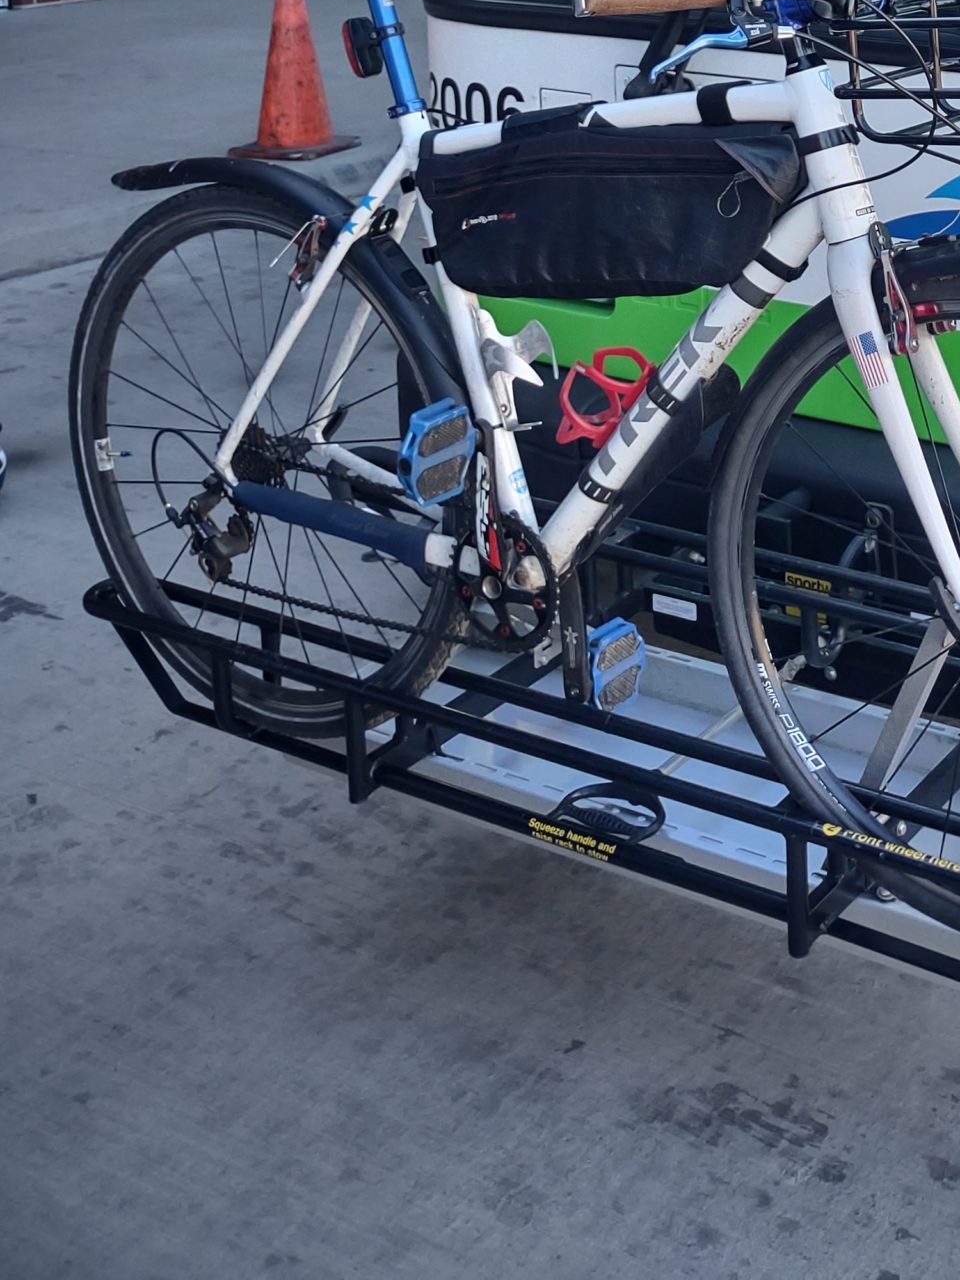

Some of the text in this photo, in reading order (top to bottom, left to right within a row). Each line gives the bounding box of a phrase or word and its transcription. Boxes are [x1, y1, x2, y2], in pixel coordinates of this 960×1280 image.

[528, 818, 617, 854] Squeeze handle and
